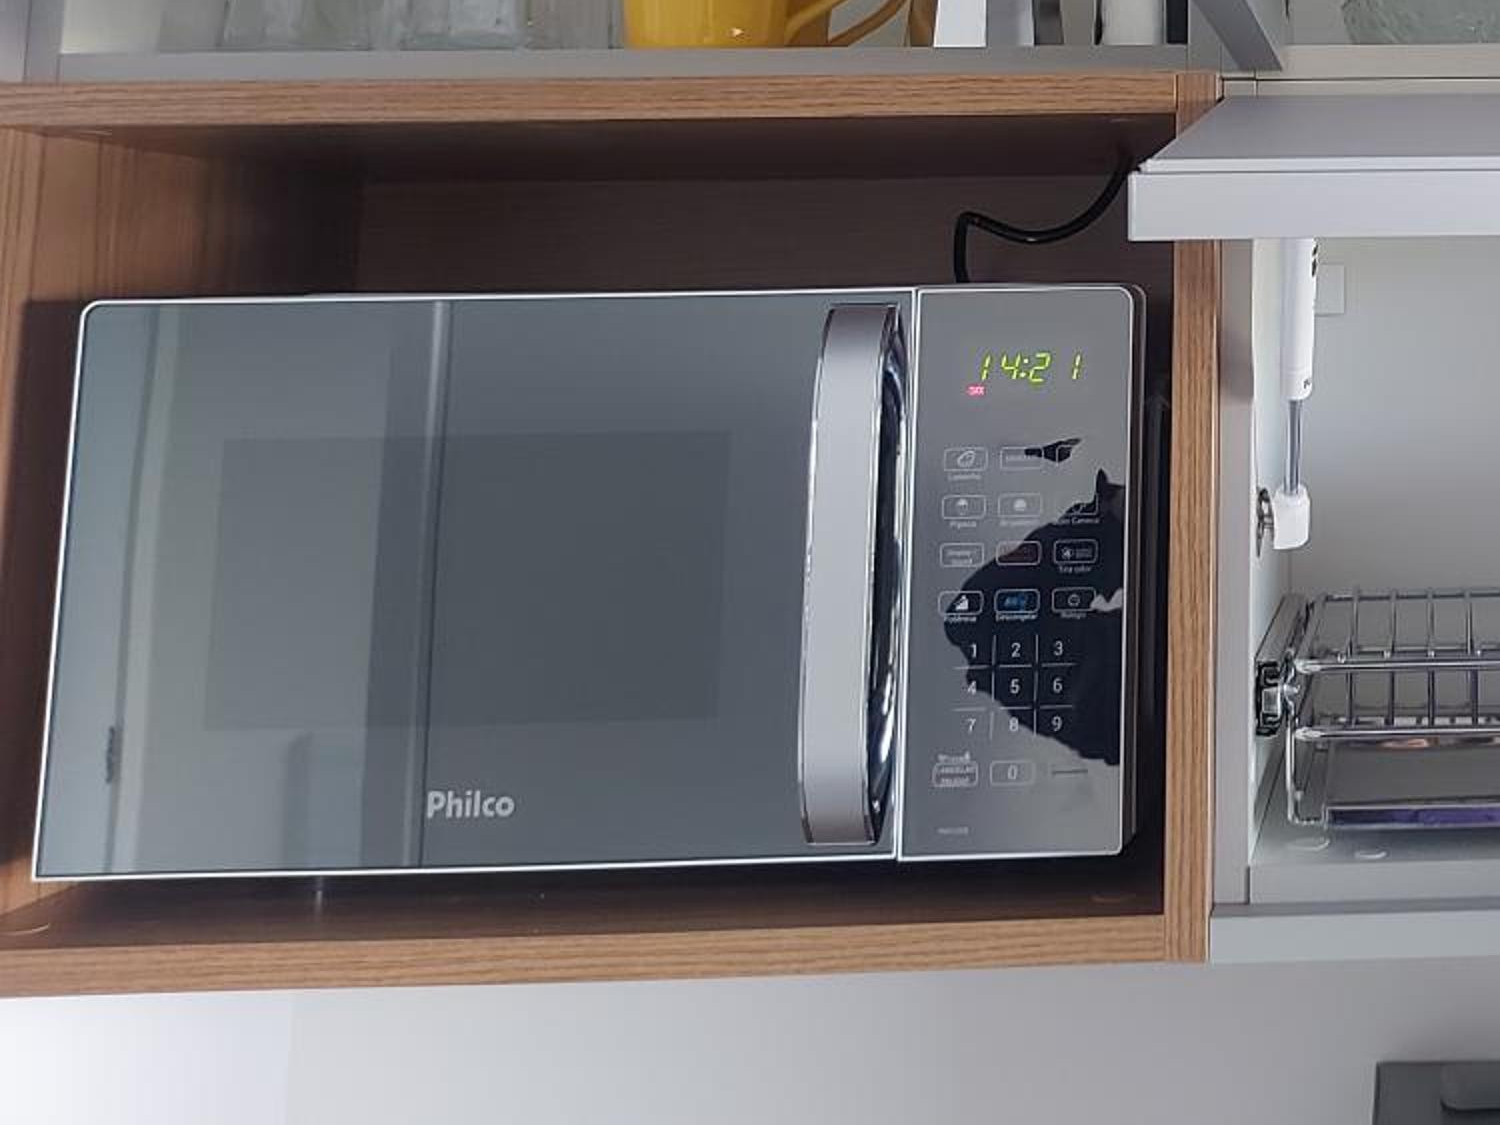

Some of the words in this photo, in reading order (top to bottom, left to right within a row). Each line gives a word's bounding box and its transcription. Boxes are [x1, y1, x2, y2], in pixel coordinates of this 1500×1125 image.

[980, 353, 1082, 382] 14:21
[970, 644, 977, 656] 1
[1011, 642, 1021, 657] 2
[1054, 640, 1064, 656] 3
[967, 681, 977, 694] 4
[1010, 679, 1020, 694] 5
[1053, 678, 1063, 693] 6
[967, 718, 976, 731] 7
[1009, 717, 1019, 731] 8
[1052, 716, 1062, 731] 9
[1007, 765, 1018, 780] 0
[427, 790, 515, 819] Philco
